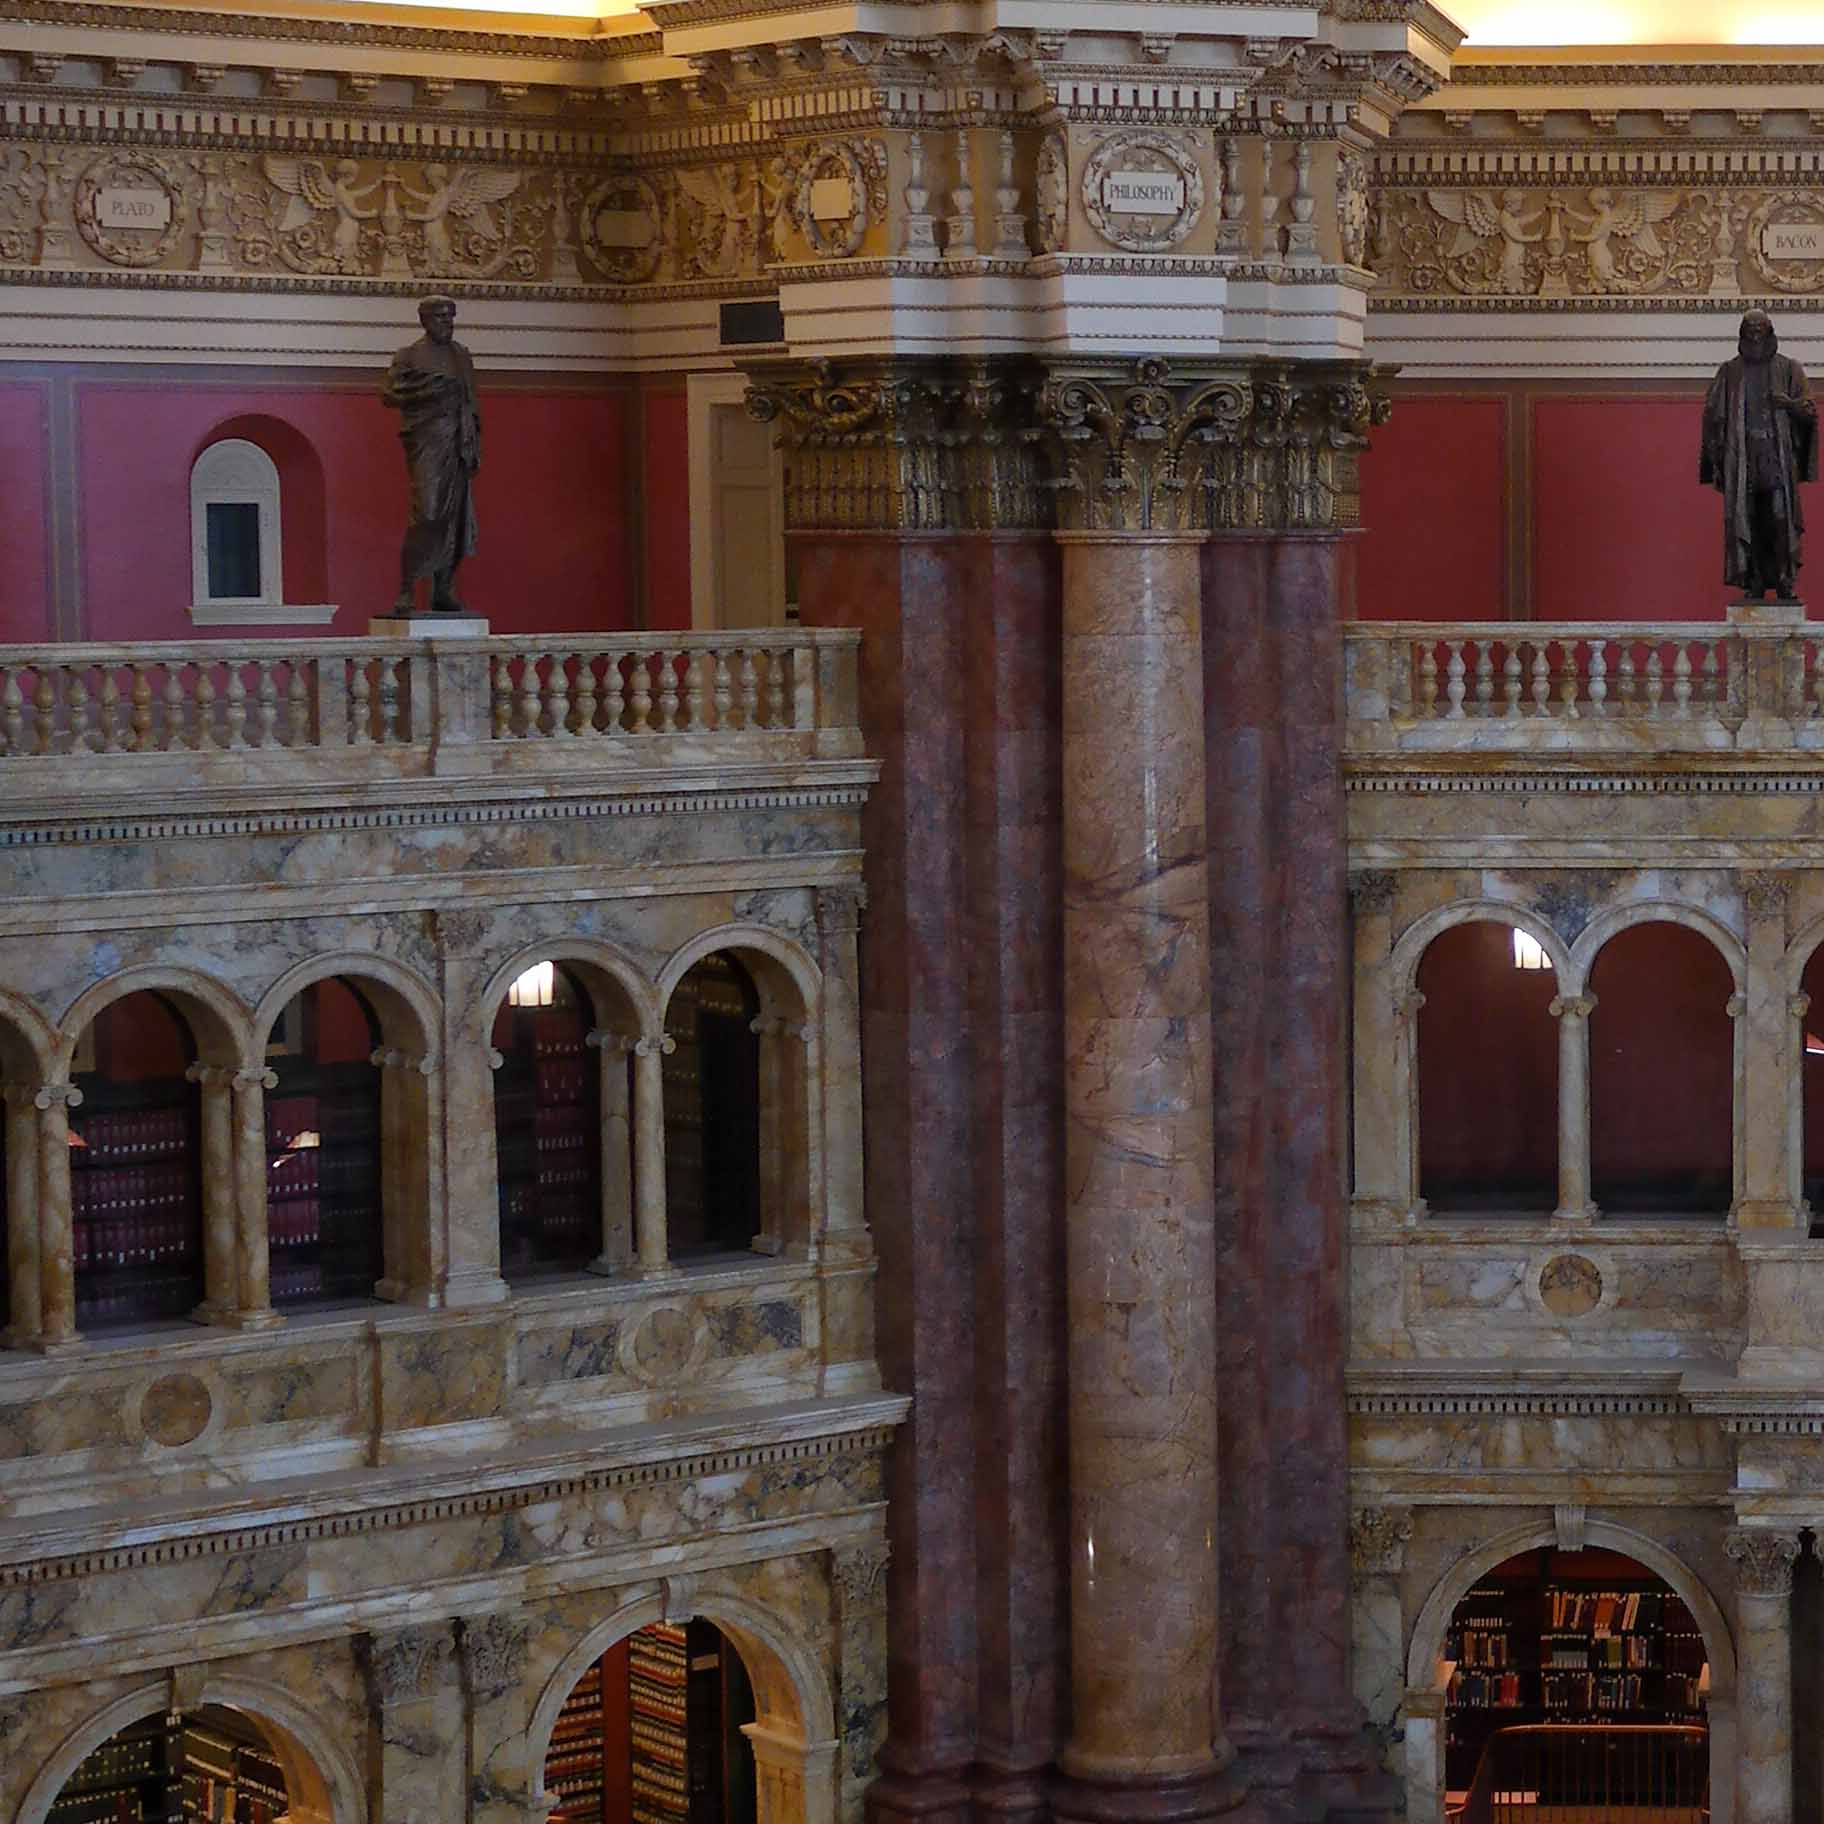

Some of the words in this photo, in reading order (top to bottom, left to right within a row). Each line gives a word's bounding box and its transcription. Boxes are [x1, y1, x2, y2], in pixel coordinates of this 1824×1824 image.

[1110, 183, 1176, 201] PHILOSOPHY
[112, 200, 156, 217] PLATO
[1776, 234, 1817, 249] BACON
